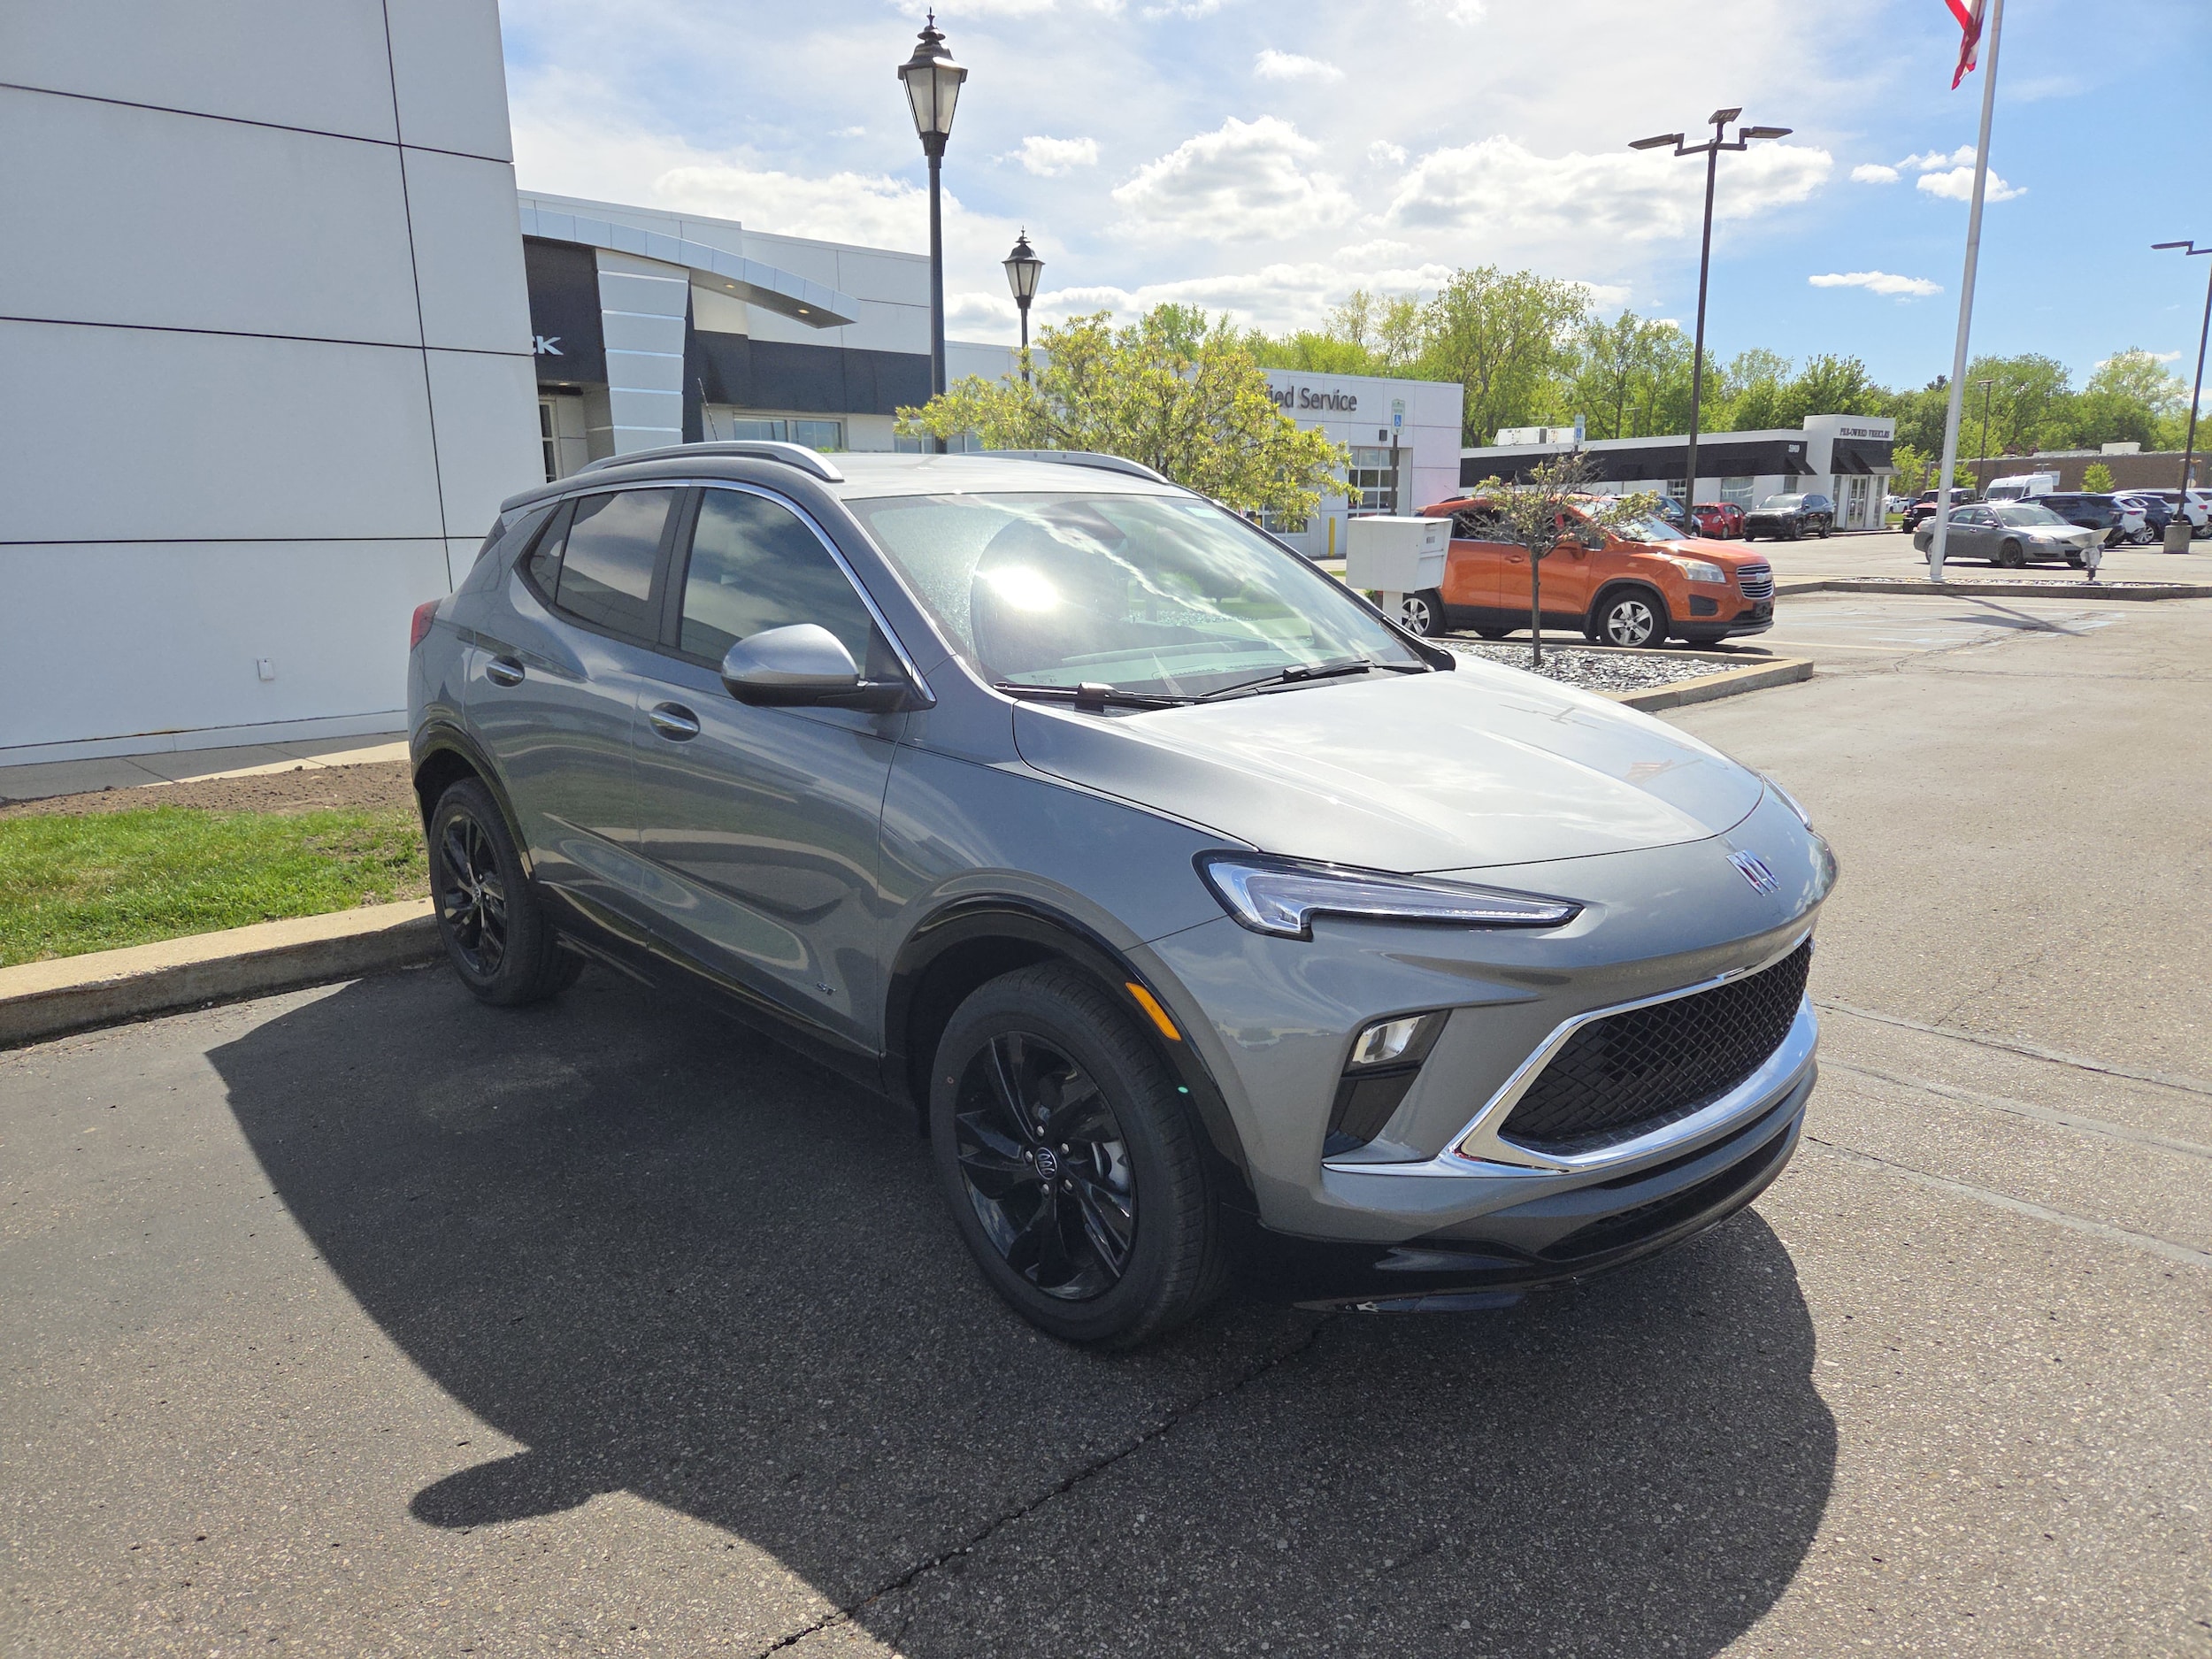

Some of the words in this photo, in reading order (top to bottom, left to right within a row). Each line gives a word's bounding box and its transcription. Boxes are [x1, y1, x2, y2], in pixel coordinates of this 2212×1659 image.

[533, 335, 565, 356] K
[1265, 384, 1294, 408] ied
[1300, 388, 1357, 411] Service
